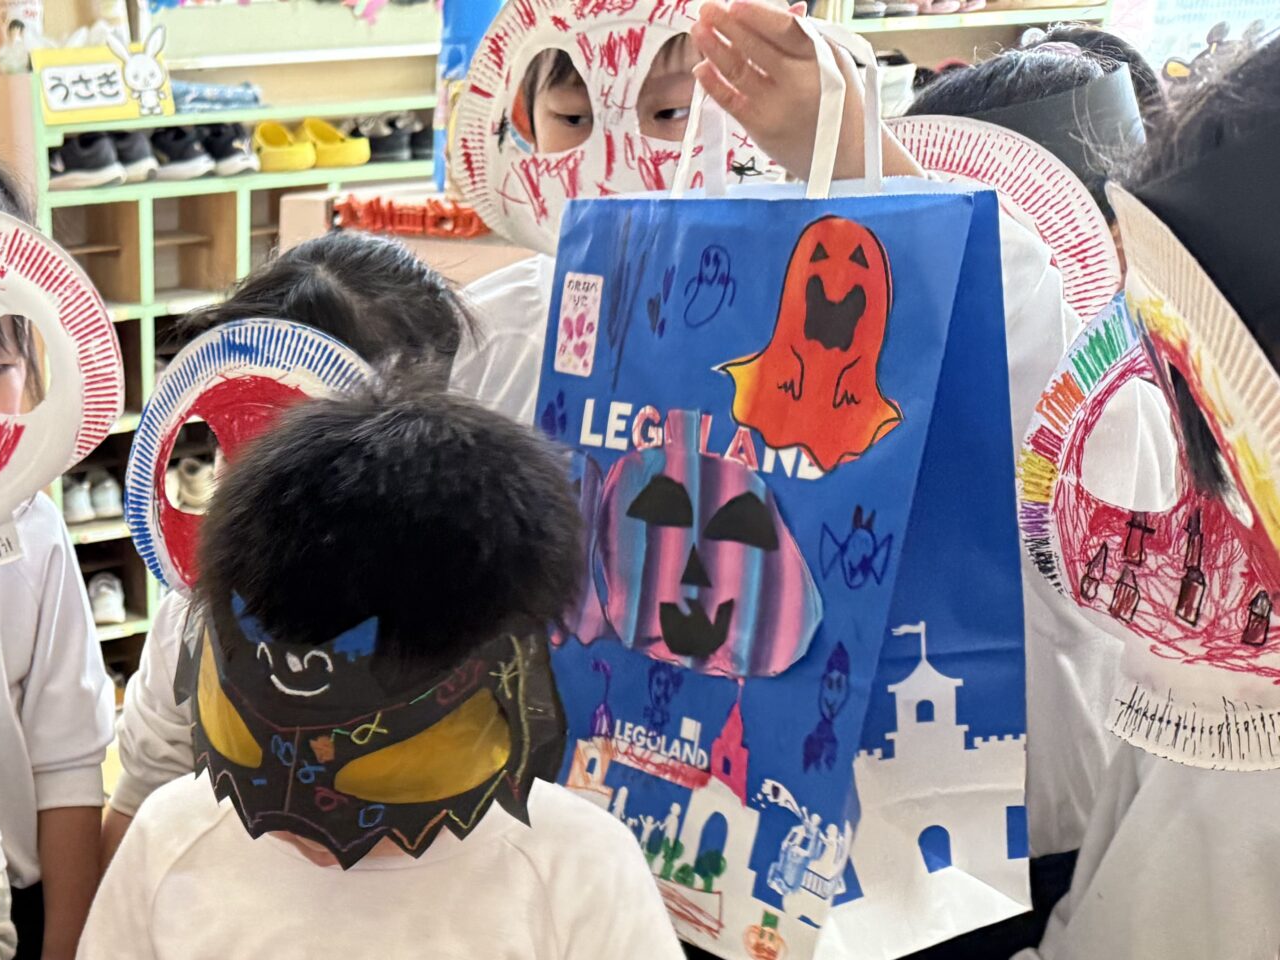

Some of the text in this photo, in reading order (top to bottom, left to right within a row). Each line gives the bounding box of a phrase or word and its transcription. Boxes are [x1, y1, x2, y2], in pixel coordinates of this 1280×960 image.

[49, 69, 121, 103] うさぎ
[580, 398, 825, 480] LEGLAN
[614, 719, 708, 770] LEGOLAND
